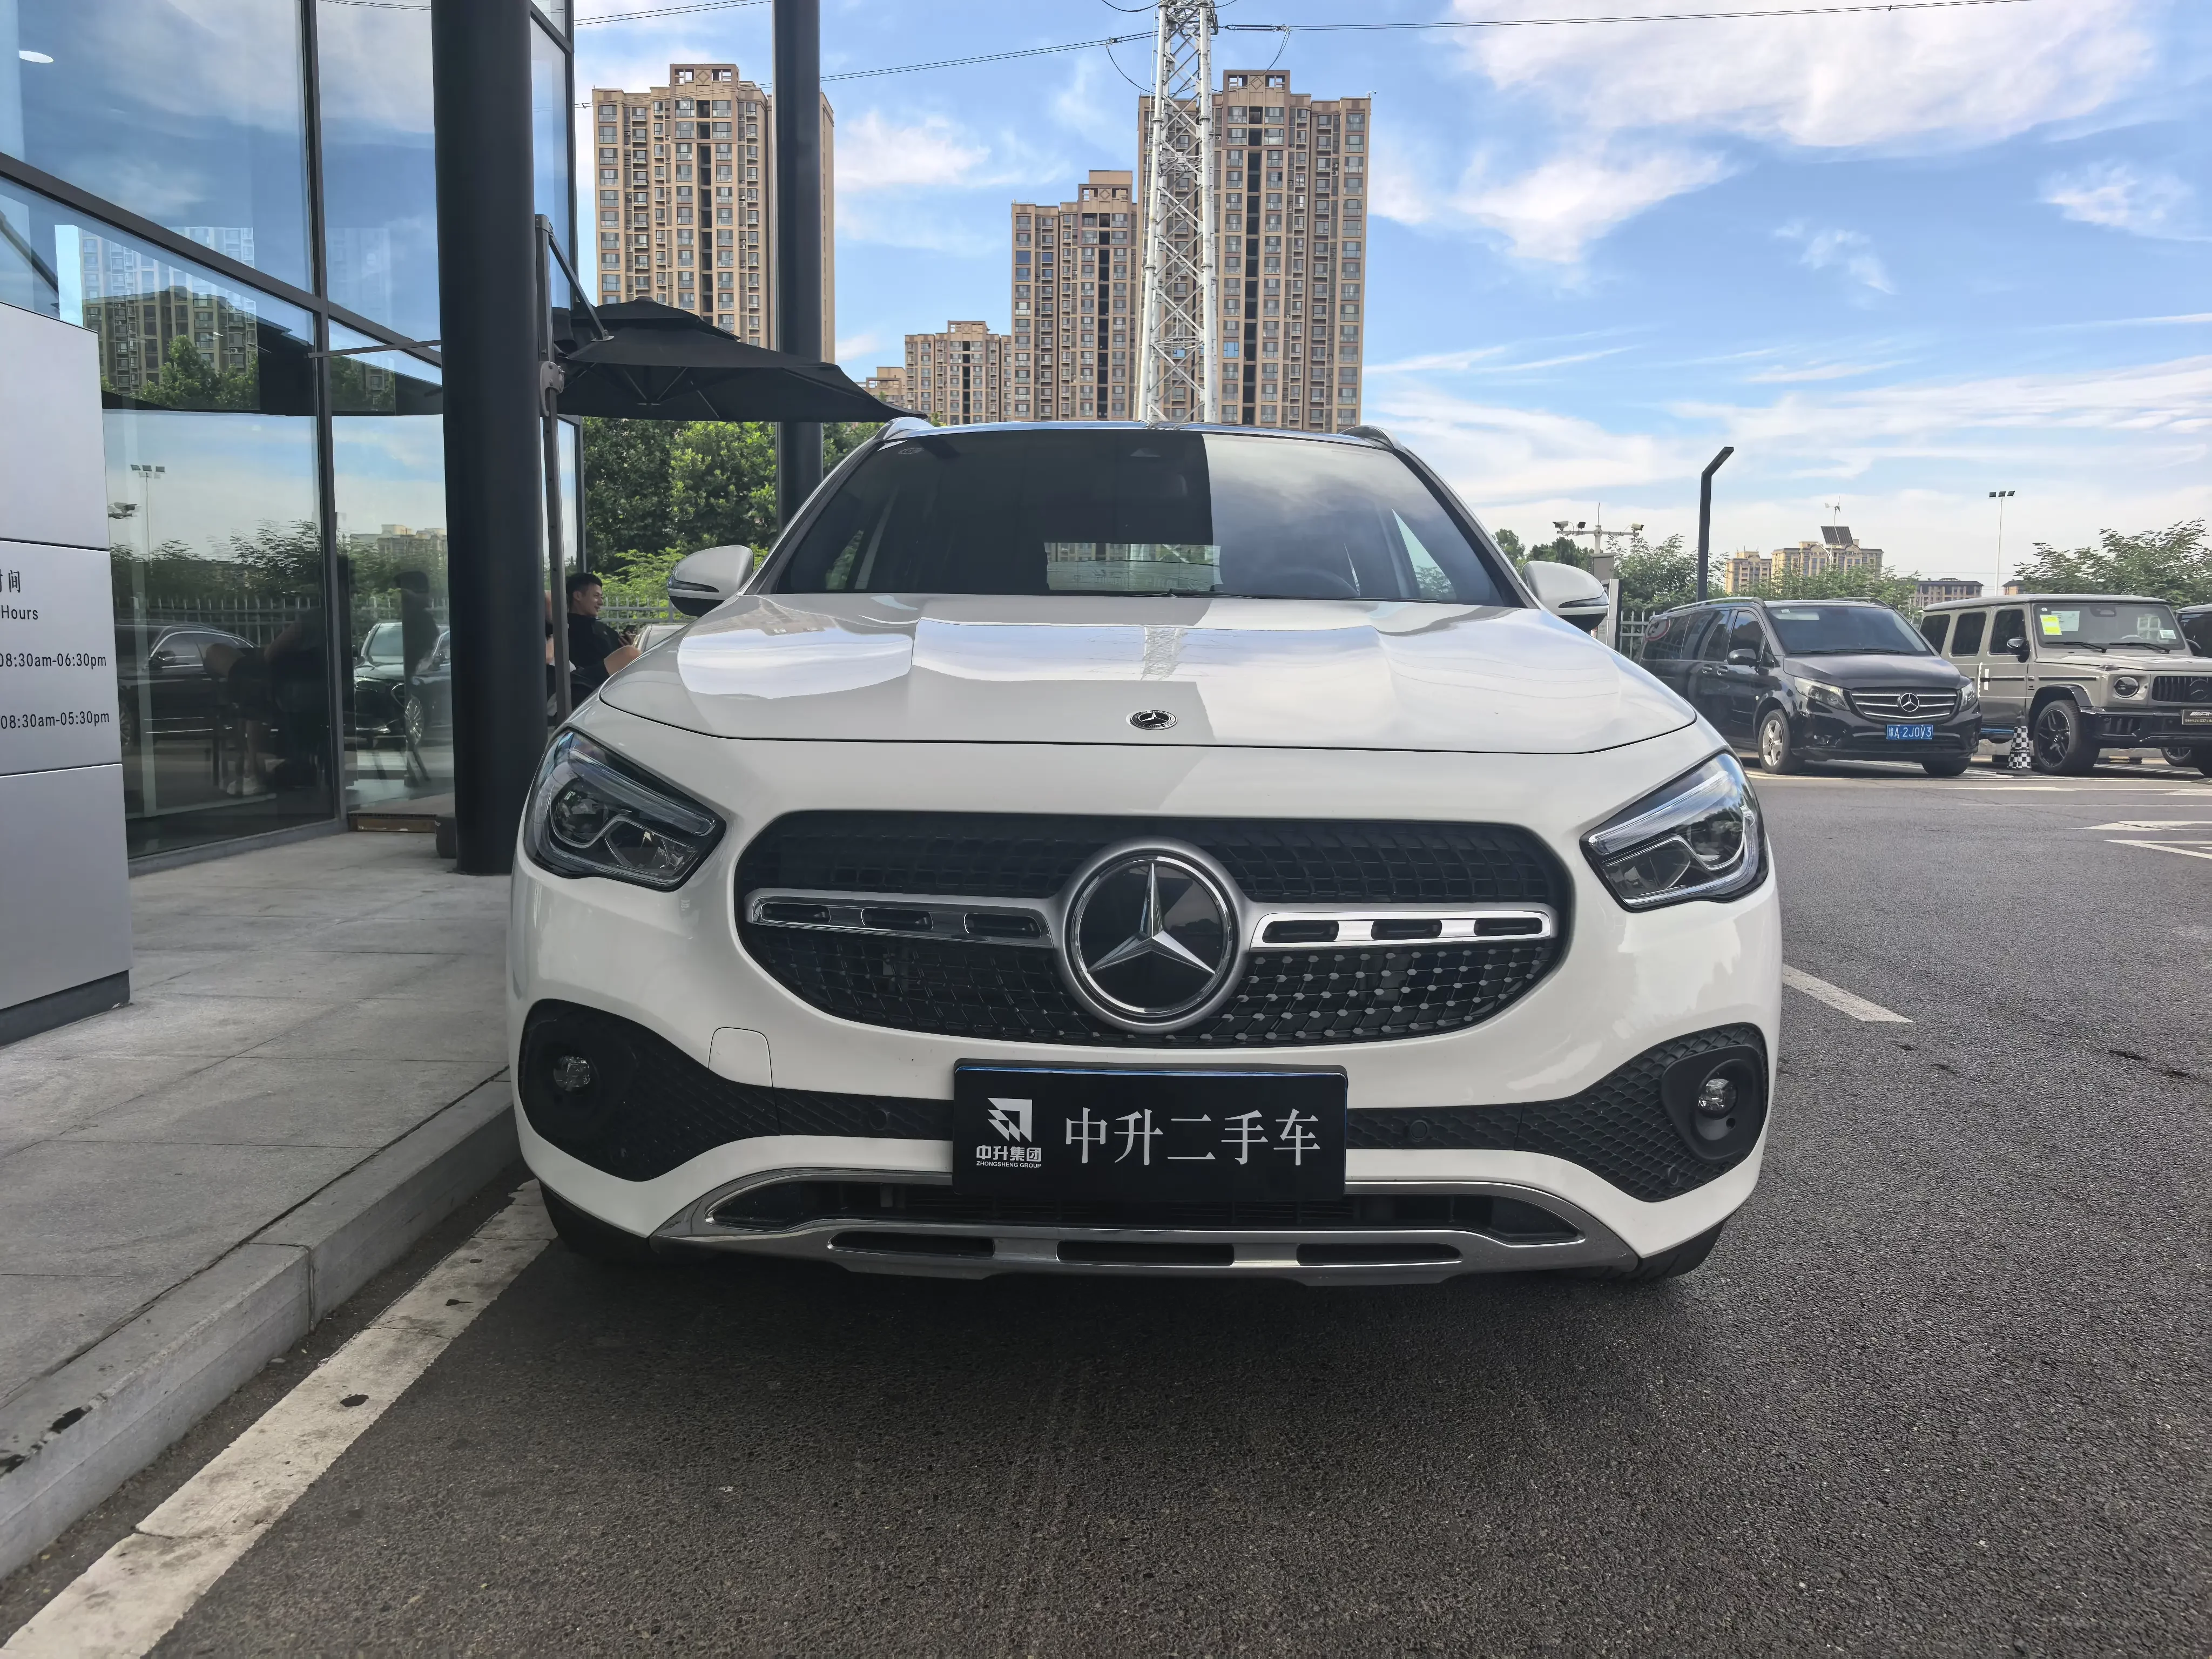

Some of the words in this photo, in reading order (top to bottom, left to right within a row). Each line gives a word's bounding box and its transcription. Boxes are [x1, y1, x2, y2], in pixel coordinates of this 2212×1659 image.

[0, 569, 21, 593] 间
[1, 604, 38, 620] Hours
[0, 653, 106, 670] 08:30am-06:30pm
[1, 711, 110, 729] 08:30am-05:30pm
[1065, 1107, 1320, 1166] 中升二手车
[976, 1145, 1042, 1162] 中升集团
